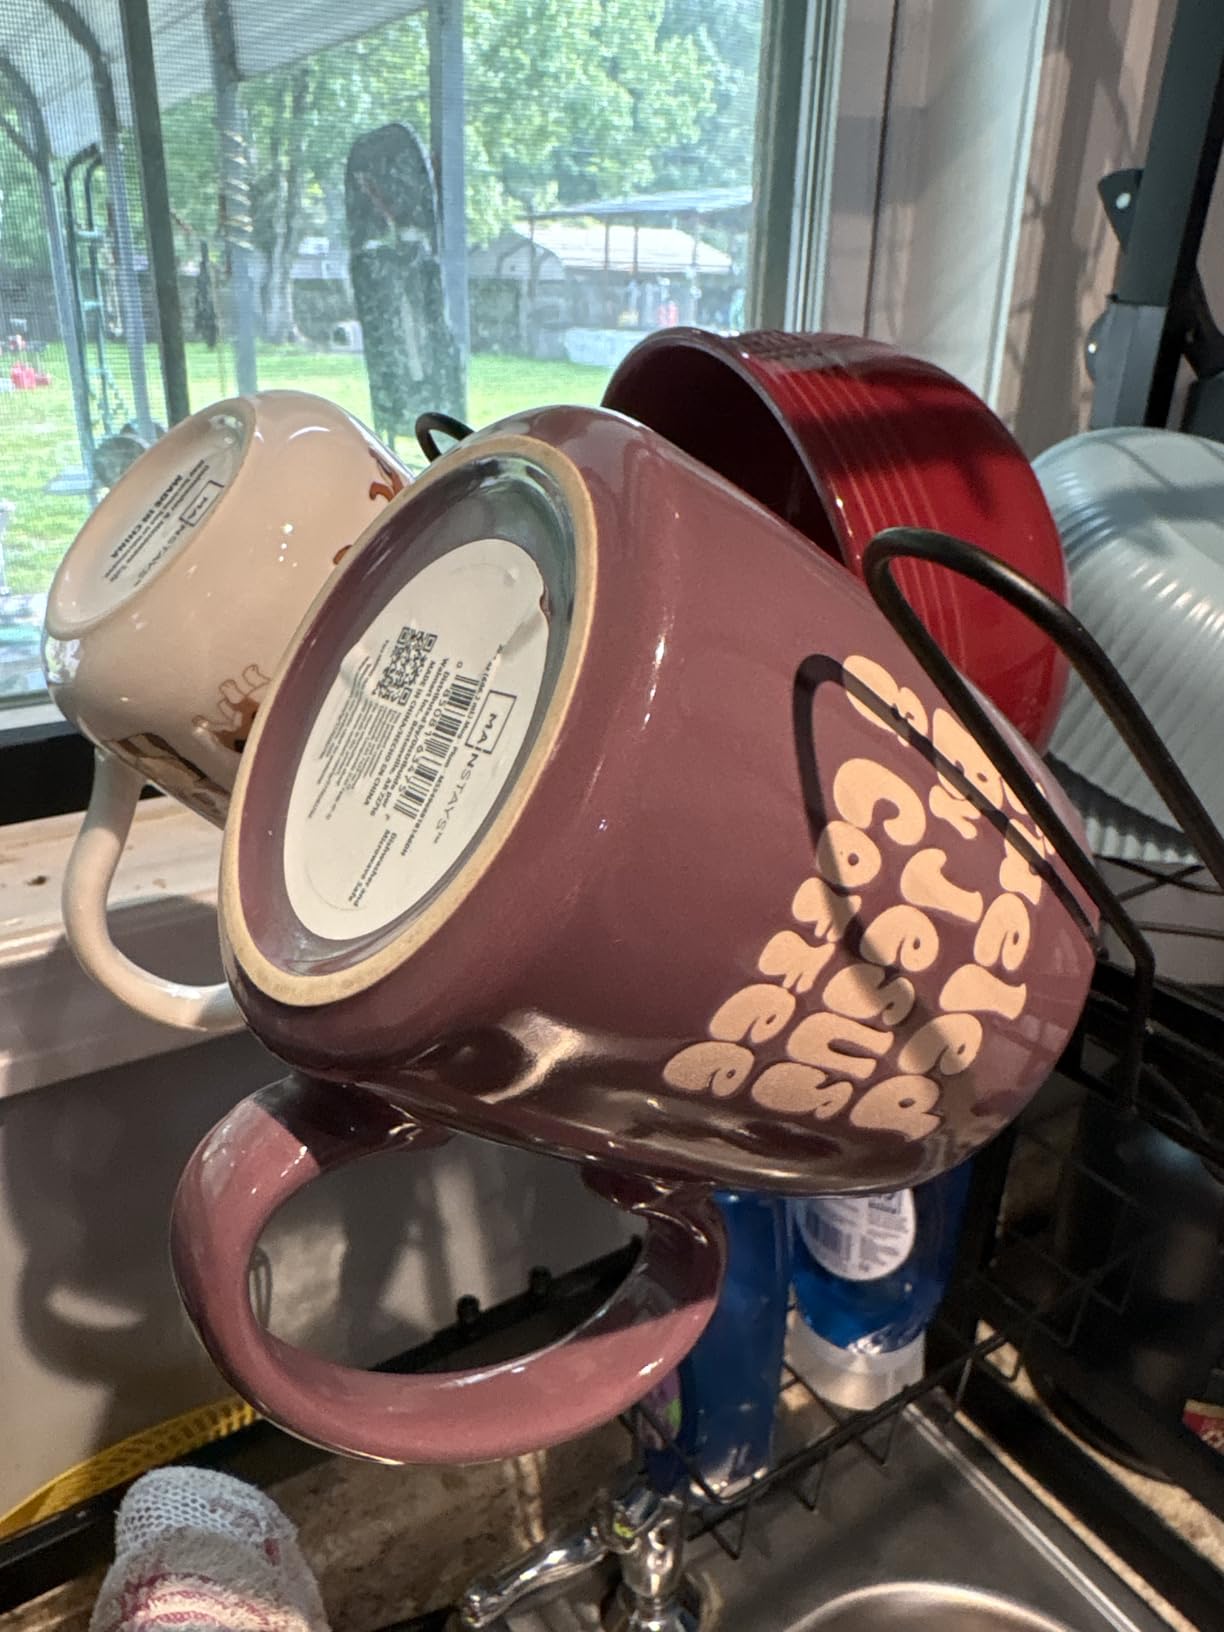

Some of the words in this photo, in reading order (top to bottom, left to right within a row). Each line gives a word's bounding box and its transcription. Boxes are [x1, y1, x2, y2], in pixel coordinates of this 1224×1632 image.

[152, 474, 183, 508] MADE
[141, 508, 155, 523] IN
[109, 522, 142, 559] CHINA
[419, 660, 435, 687] MADE
[425, 656, 449, 697] Walmart
[420, 670, 450, 723] Distributed
[423, 687, 452, 736] 85081
[383, 699, 417, 762] CHINA/HECHO
[377, 763, 387, 776] EN
[396, 744, 425, 793] 63475
[363, 777, 381, 806] CHINA
[380, 790, 392, 807] por
[361, 829, 390, 880] Microwave
[365, 832, 397, 887] Dishwasher
[348, 881, 362, 900] Safe
[353, 888, 366, 907] and
